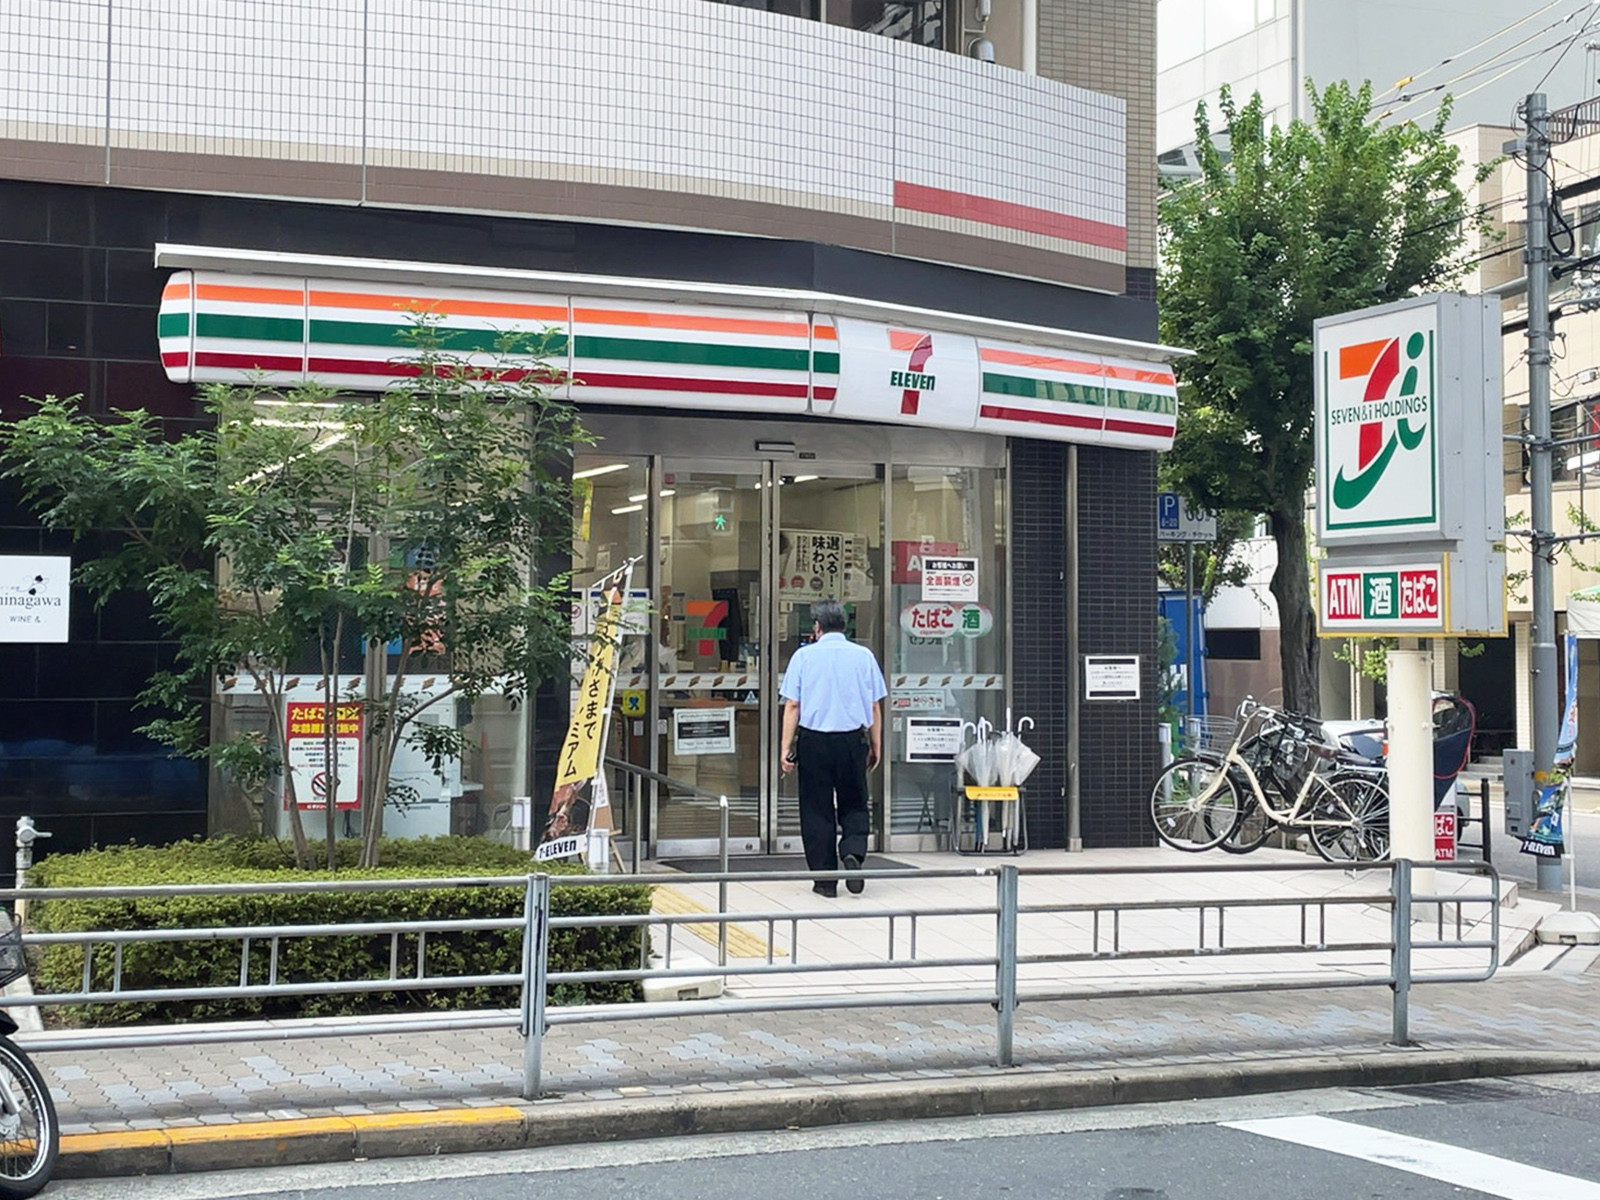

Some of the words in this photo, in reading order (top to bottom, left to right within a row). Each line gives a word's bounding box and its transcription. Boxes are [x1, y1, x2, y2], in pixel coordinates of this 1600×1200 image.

[1374, 395, 1428, 419] HOLDINGS
[1164, 495, 1176, 516] P
[1328, 578, 1361, 616] ATM
[1369, 577, 1393, 616] 酒
[1401, 574, 1438, 614] たばこ
[911, 607, 954, 629] たばこ
[962, 608, 980, 629] 酒
[1434, 815, 1454, 836] ばこ
